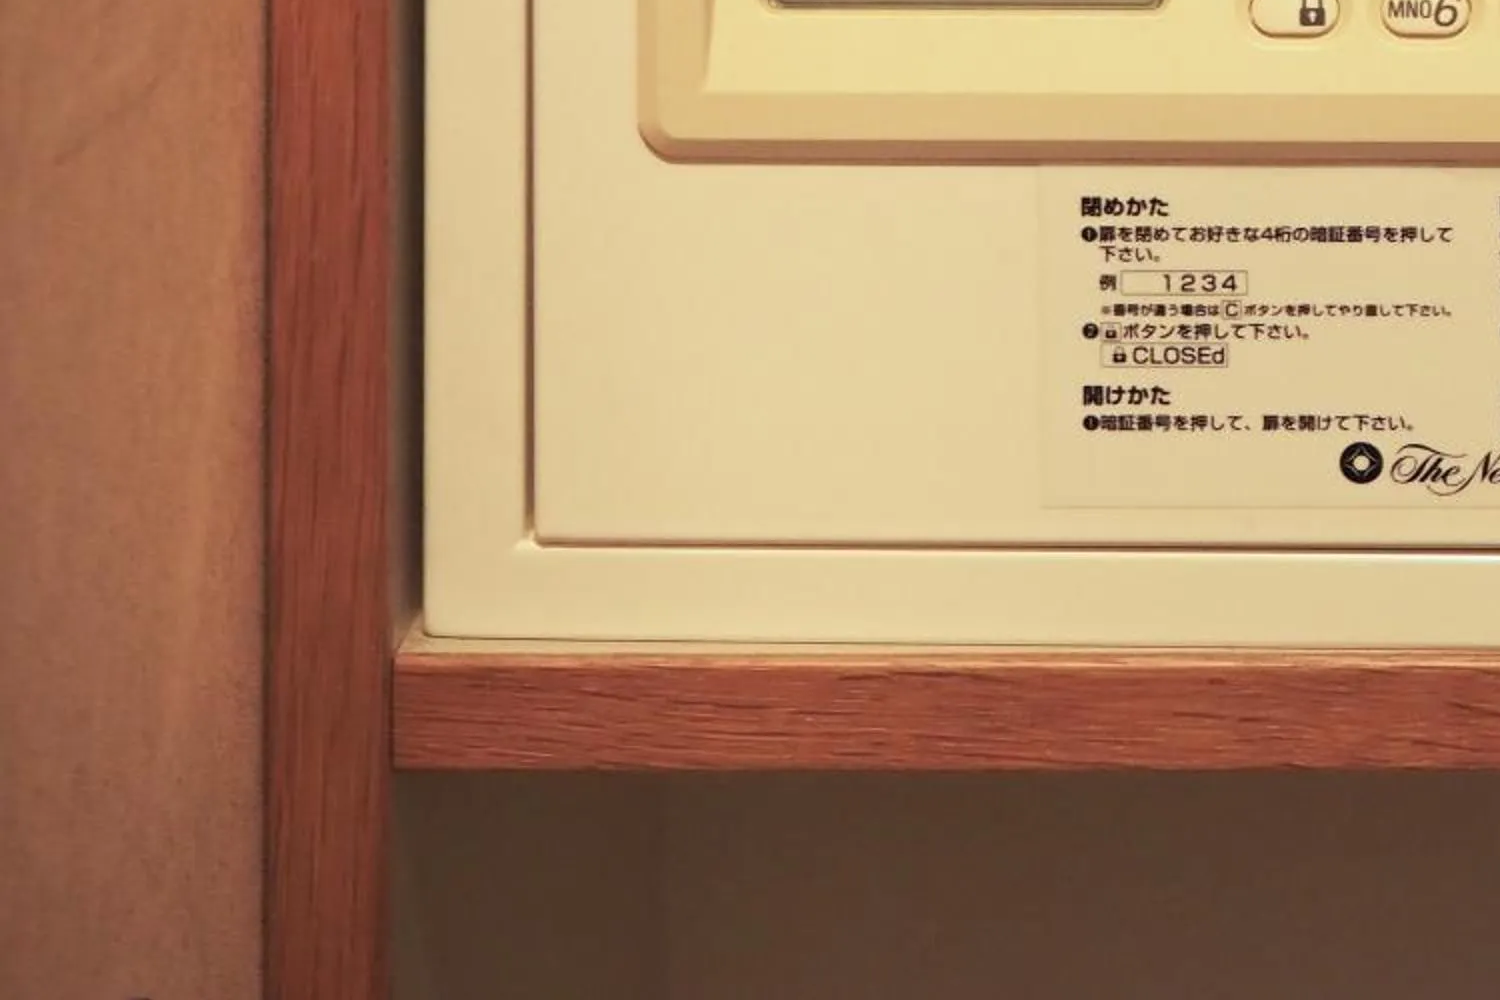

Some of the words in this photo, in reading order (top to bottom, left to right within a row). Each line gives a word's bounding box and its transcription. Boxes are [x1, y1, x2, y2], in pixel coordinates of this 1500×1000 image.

[1081, 198, 1168, 217] 閉めかた
[1100, 246, 1160, 263] 下さい。
[1133, 346, 1225, 364] CLOSEd
[1083, 386, 1170, 405] 開けかた
[1390, 443, 1469, 484] The
